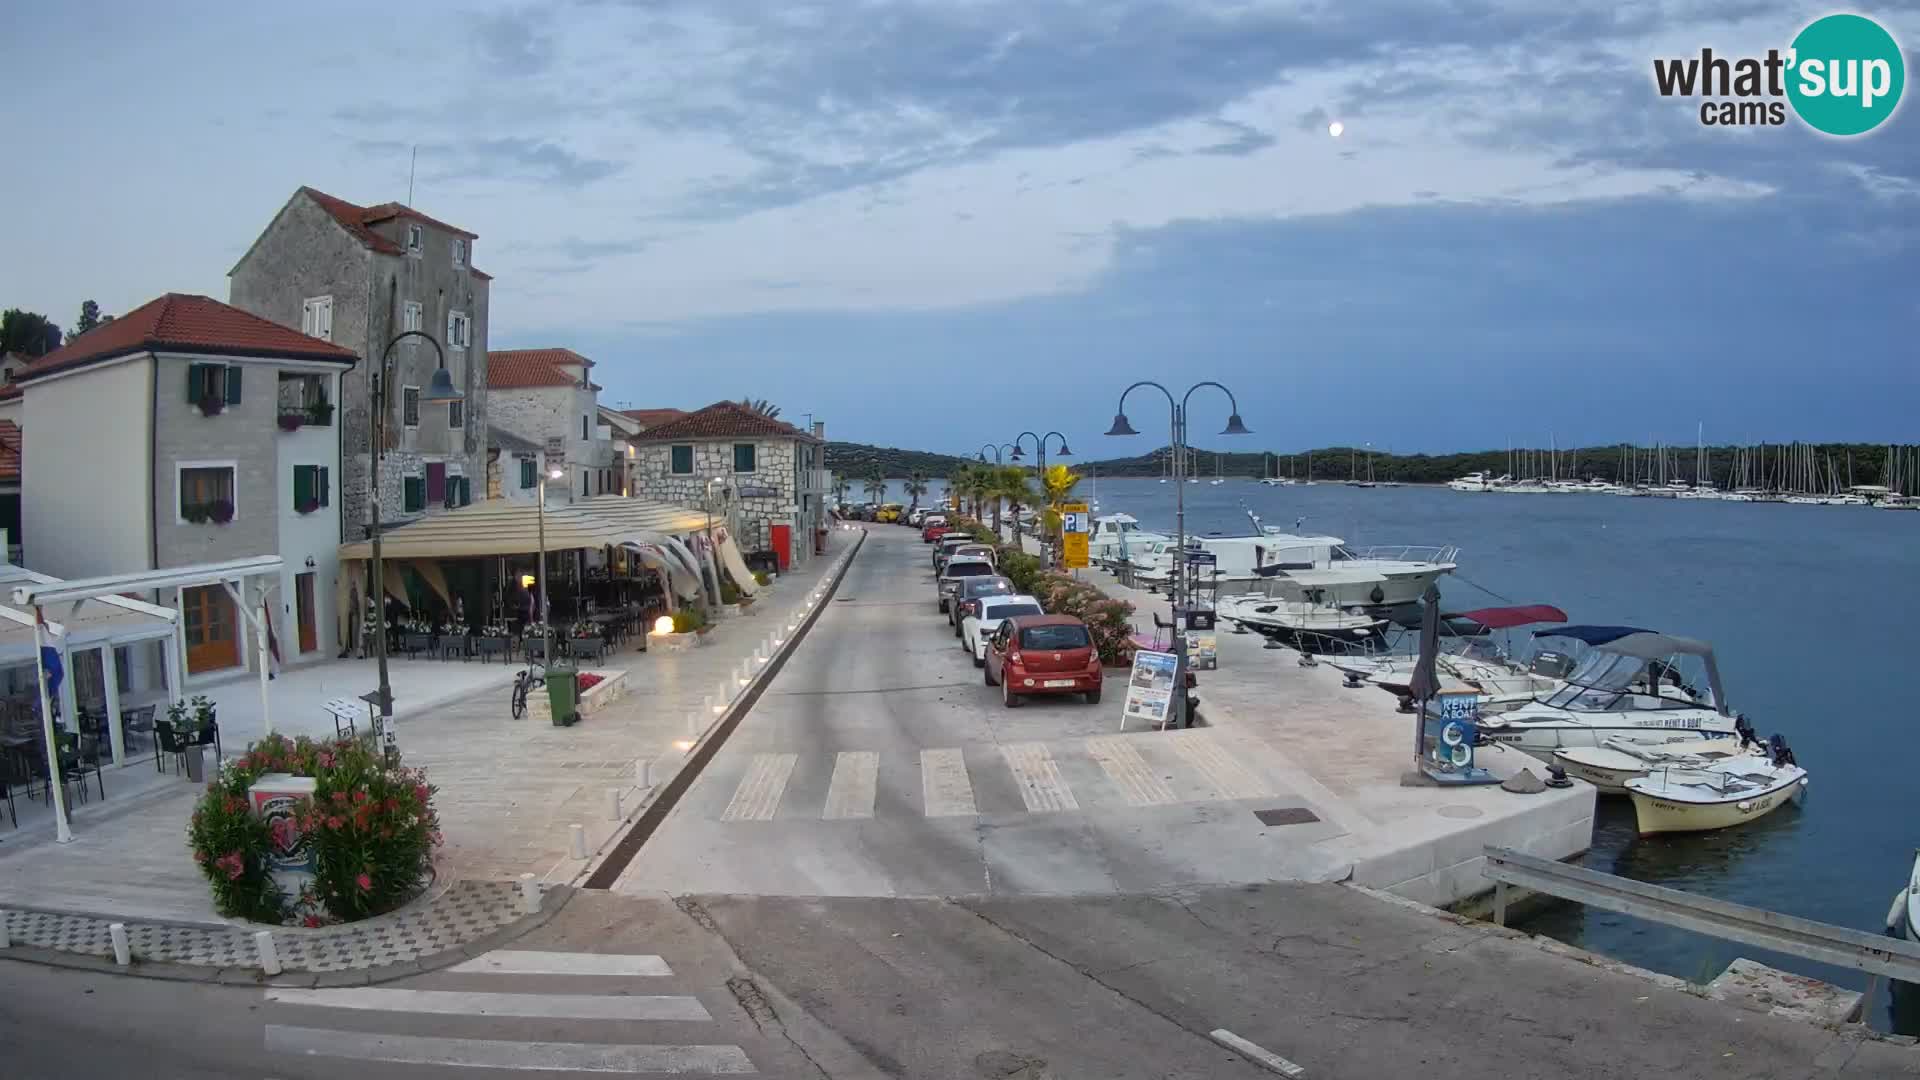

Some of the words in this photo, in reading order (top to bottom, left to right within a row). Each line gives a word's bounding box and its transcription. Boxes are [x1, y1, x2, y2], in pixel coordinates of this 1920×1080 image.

[1065, 514, 1075, 531] P
[1442, 698, 1475, 710] RENT
[1442, 710, 1450, 720] A
[1451, 709, 1474, 719] BOAT
